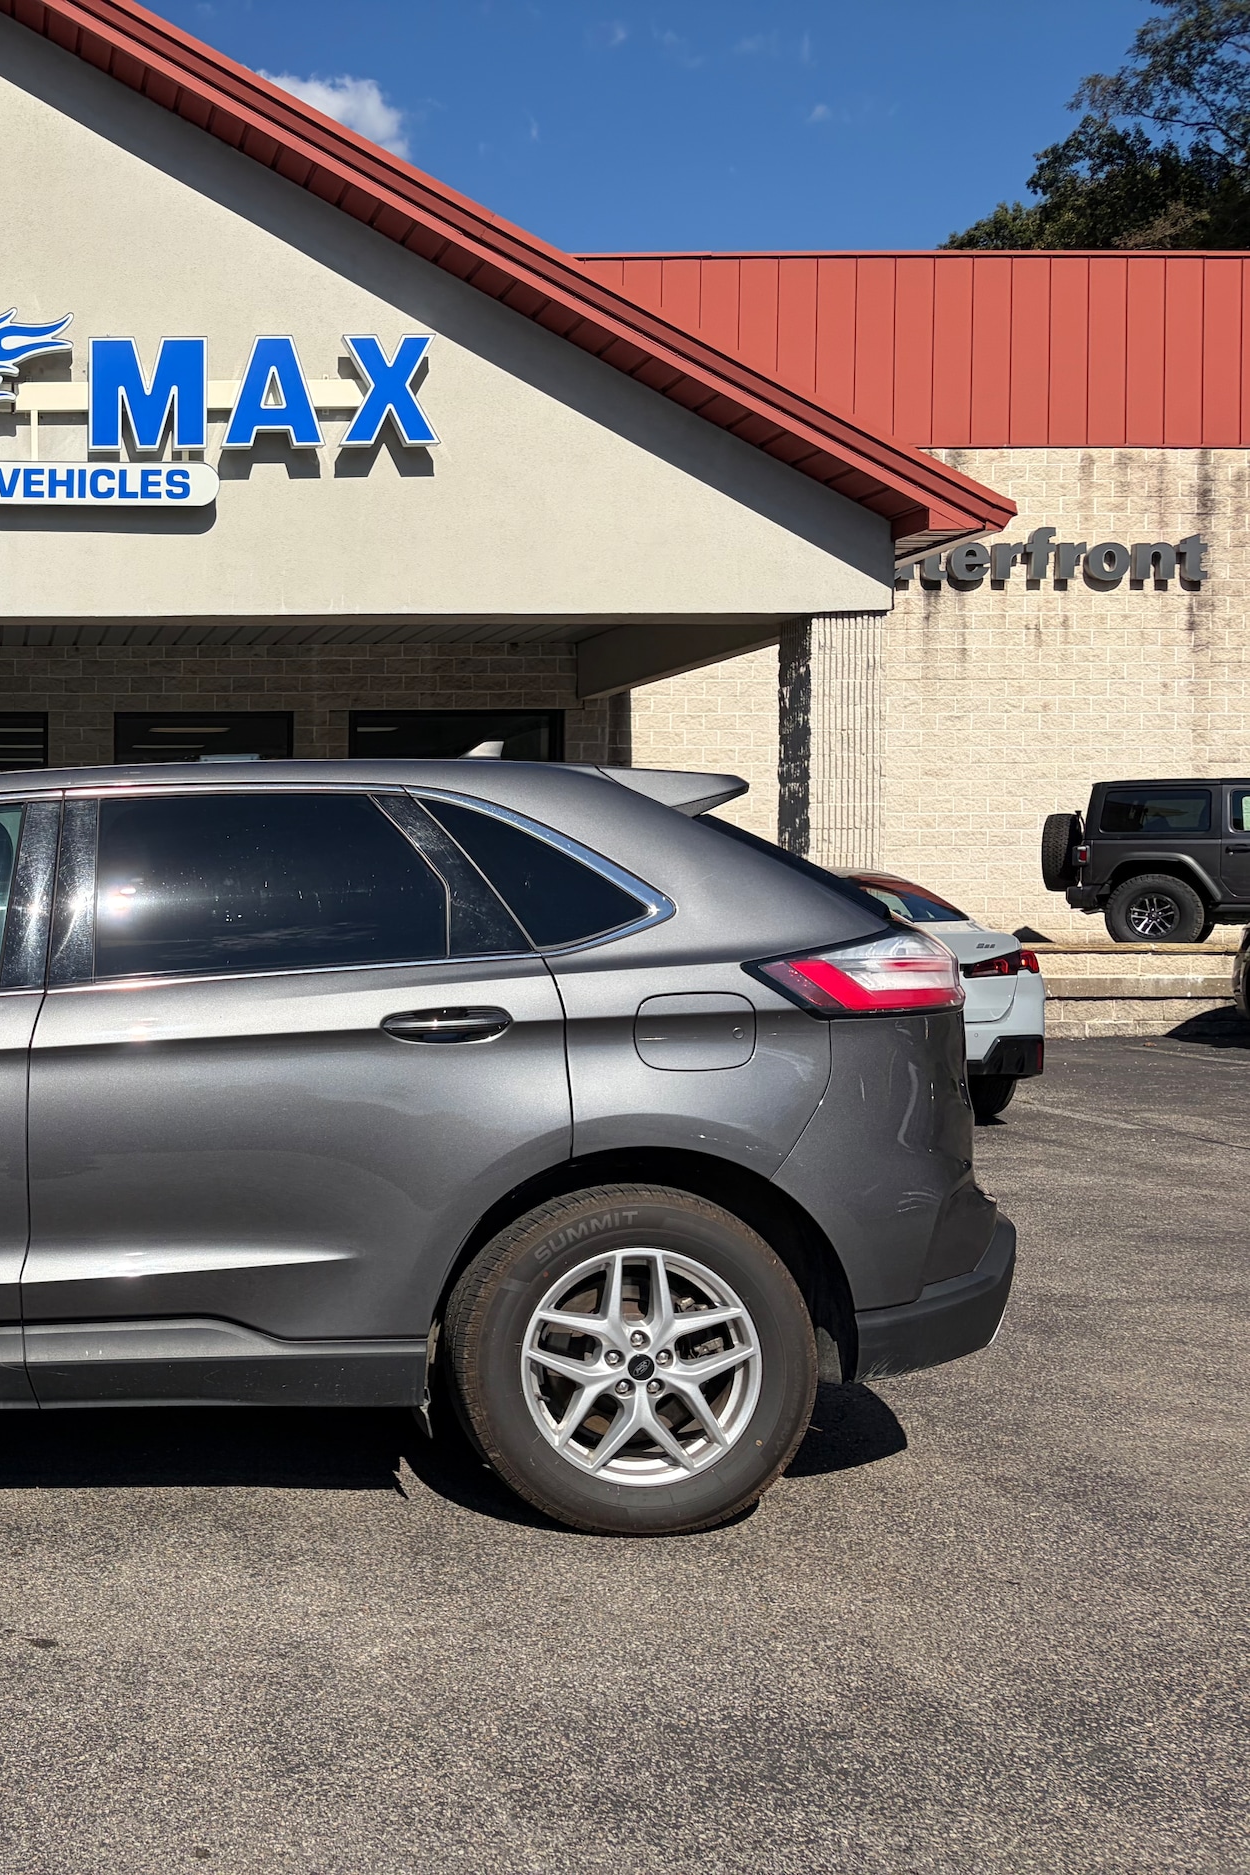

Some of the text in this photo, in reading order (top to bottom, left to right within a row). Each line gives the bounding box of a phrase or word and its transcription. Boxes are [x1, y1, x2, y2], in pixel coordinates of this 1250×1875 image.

[88, 333, 442, 453] MAX
[895, 527, 1208, 580] terfront
[534, 1211, 639, 1265] SUMMIT
